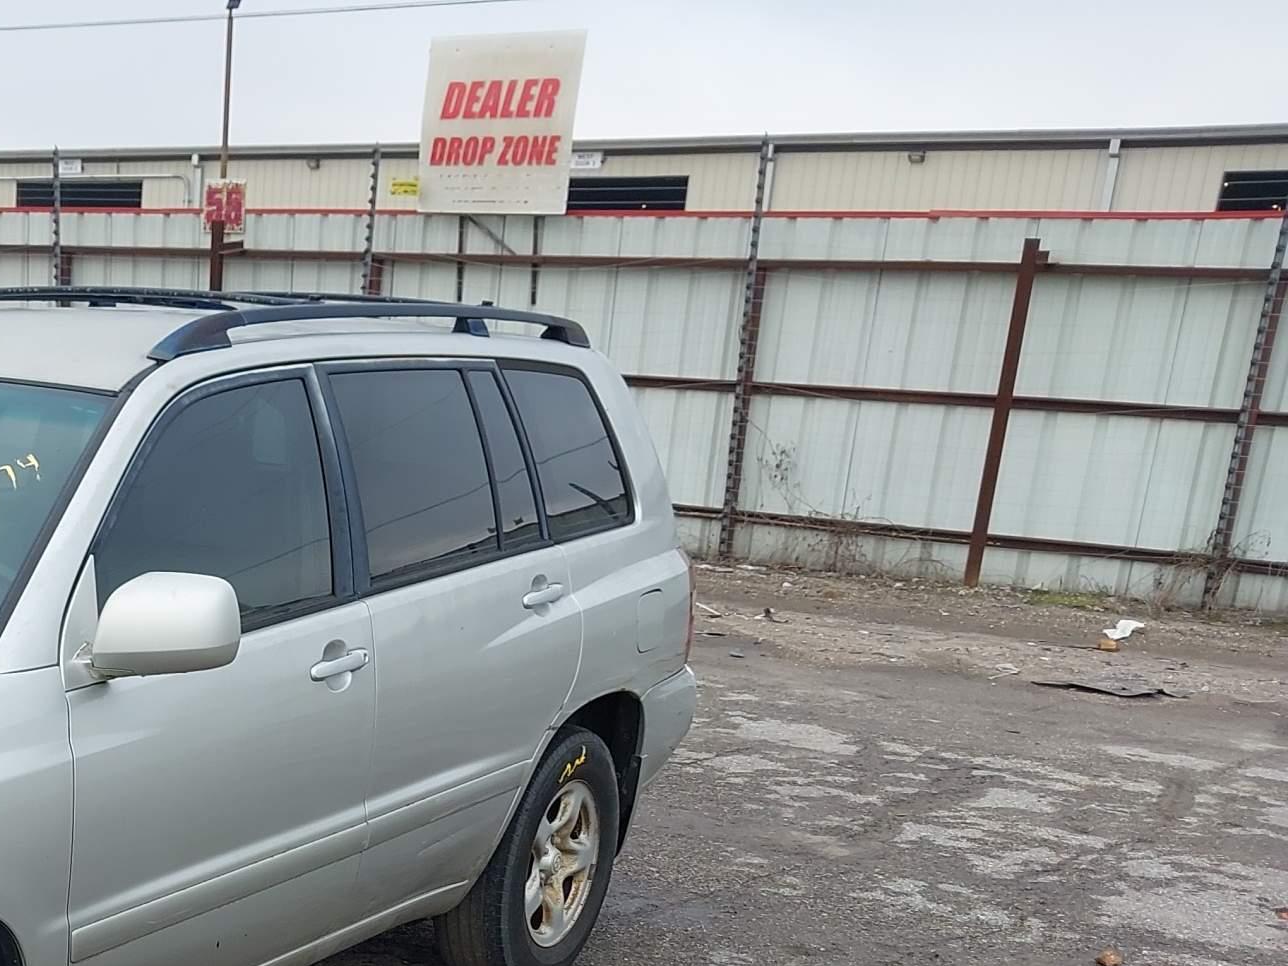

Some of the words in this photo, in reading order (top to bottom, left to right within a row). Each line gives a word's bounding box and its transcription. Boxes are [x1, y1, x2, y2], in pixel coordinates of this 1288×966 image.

[440, 78, 561, 120] DEALER
[429, 136, 496, 166] DROP
[497, 135, 561, 166] ZONE
